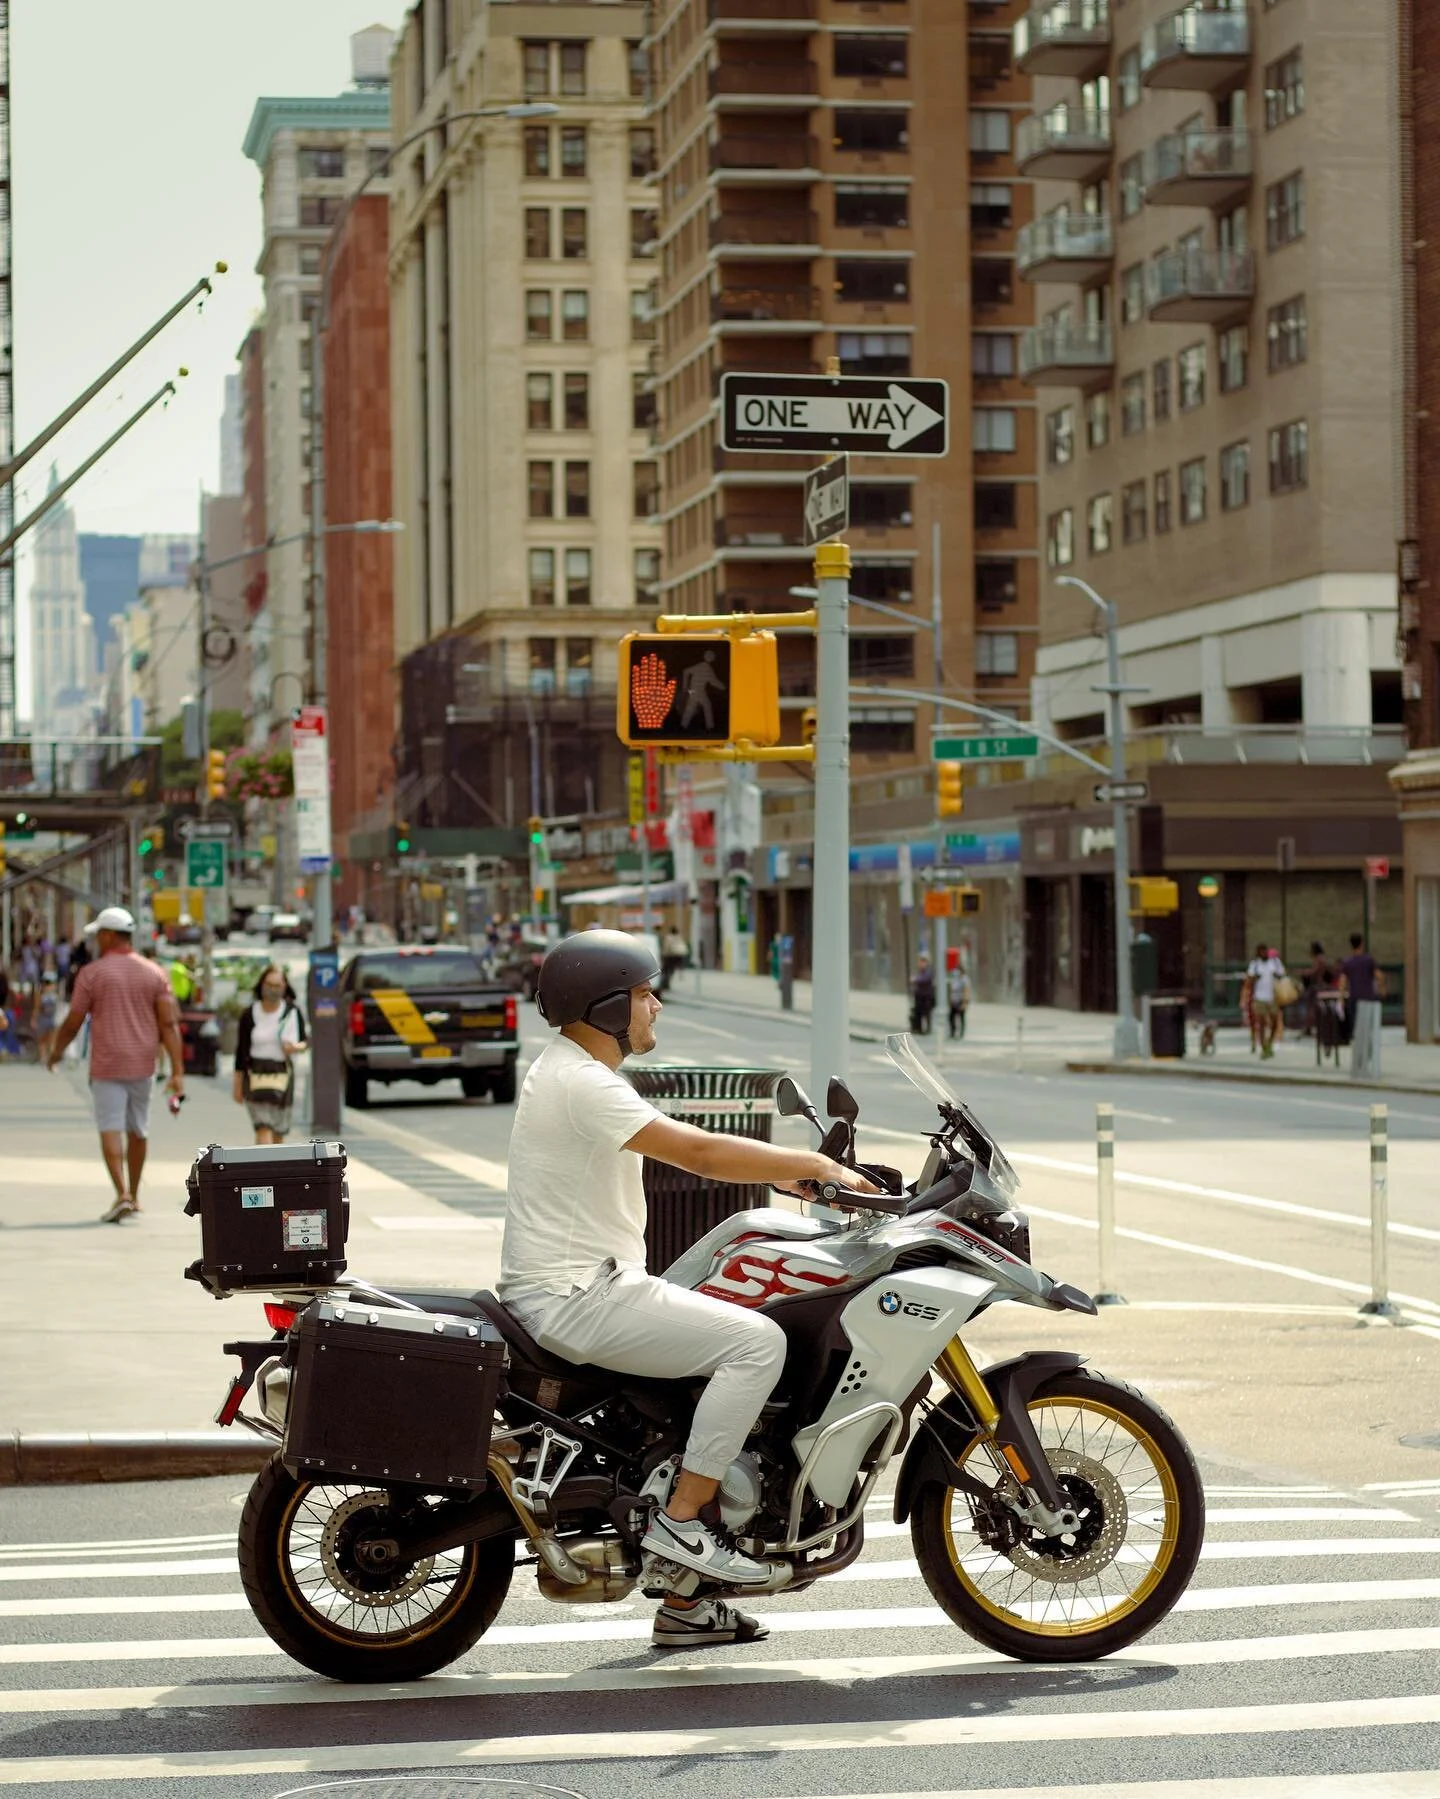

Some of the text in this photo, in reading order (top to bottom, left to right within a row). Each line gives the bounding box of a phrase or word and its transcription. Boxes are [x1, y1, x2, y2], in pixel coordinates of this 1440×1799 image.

[744, 399, 916, 431] ONE WAY
[903, 1302, 941, 1321] GS
